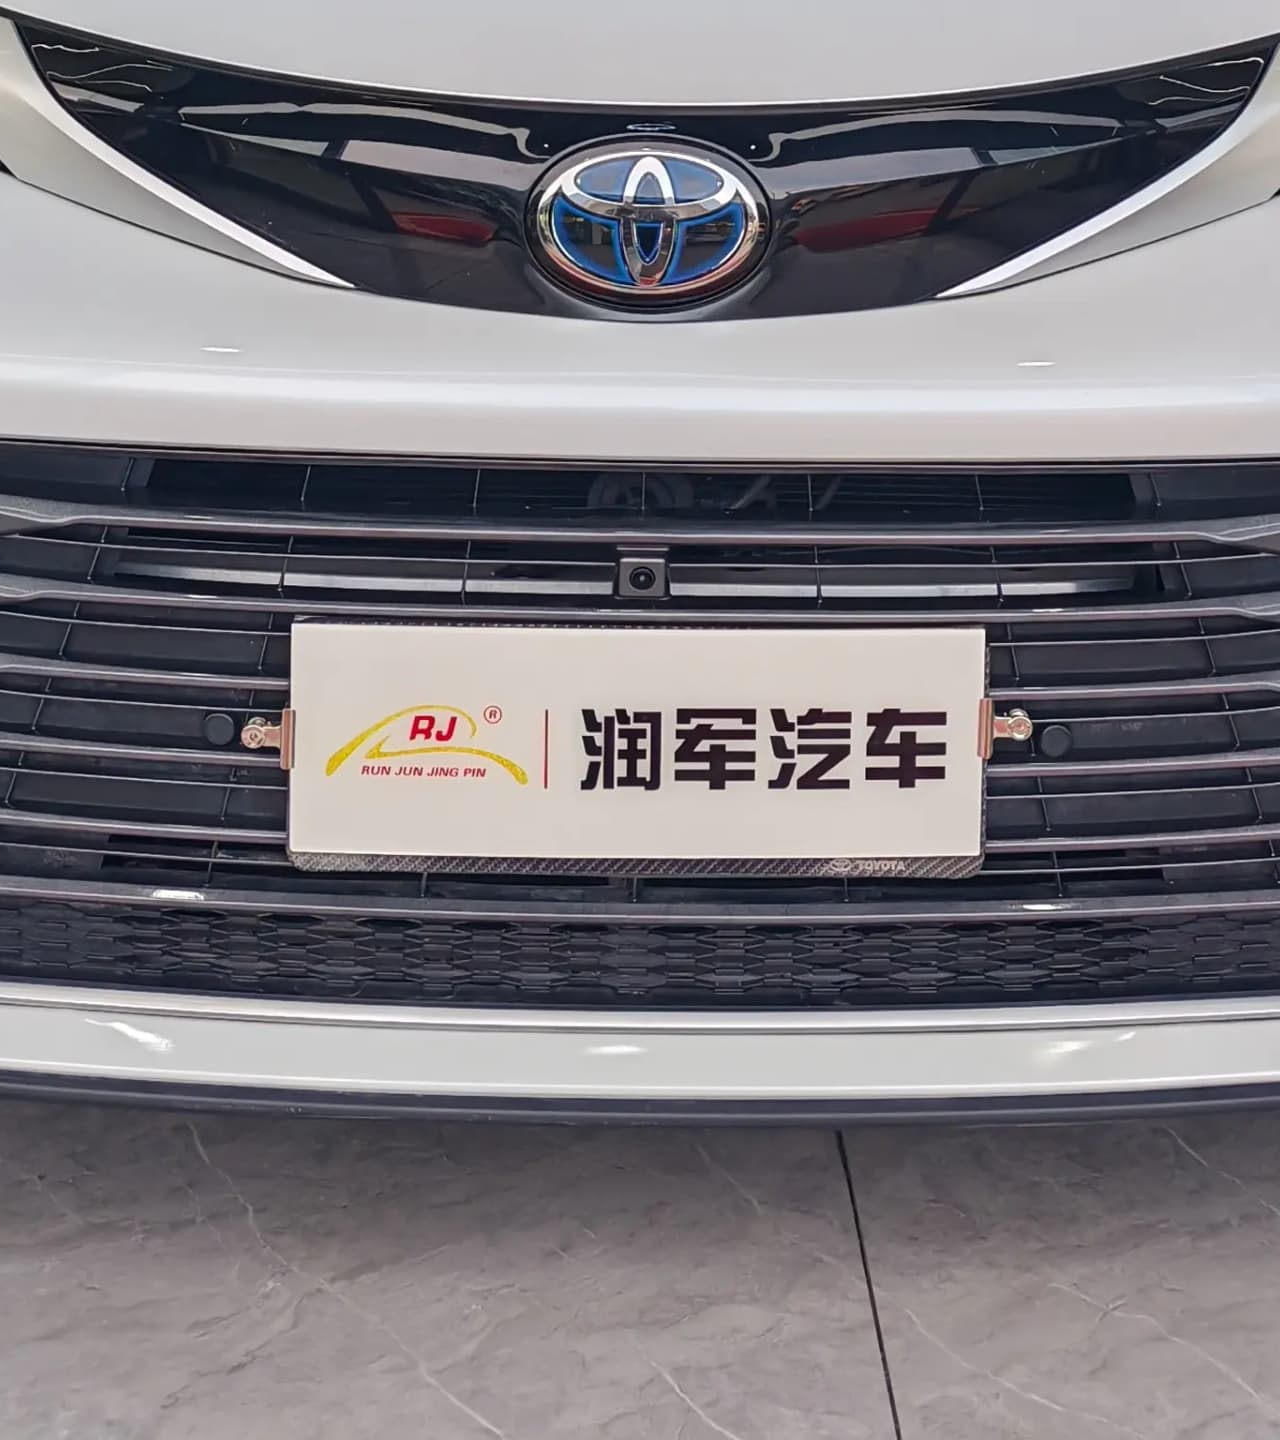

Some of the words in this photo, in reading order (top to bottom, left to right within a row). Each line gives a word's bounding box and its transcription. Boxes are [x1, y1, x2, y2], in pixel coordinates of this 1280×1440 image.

[409, 715, 458, 742] RJ
[579, 708, 948, 791] 润军汽车
[361, 765, 391, 776] RUN
[394, 766, 423, 777] JUN
[427, 767, 459, 778] JING
[463, 768, 487, 778] PIN
